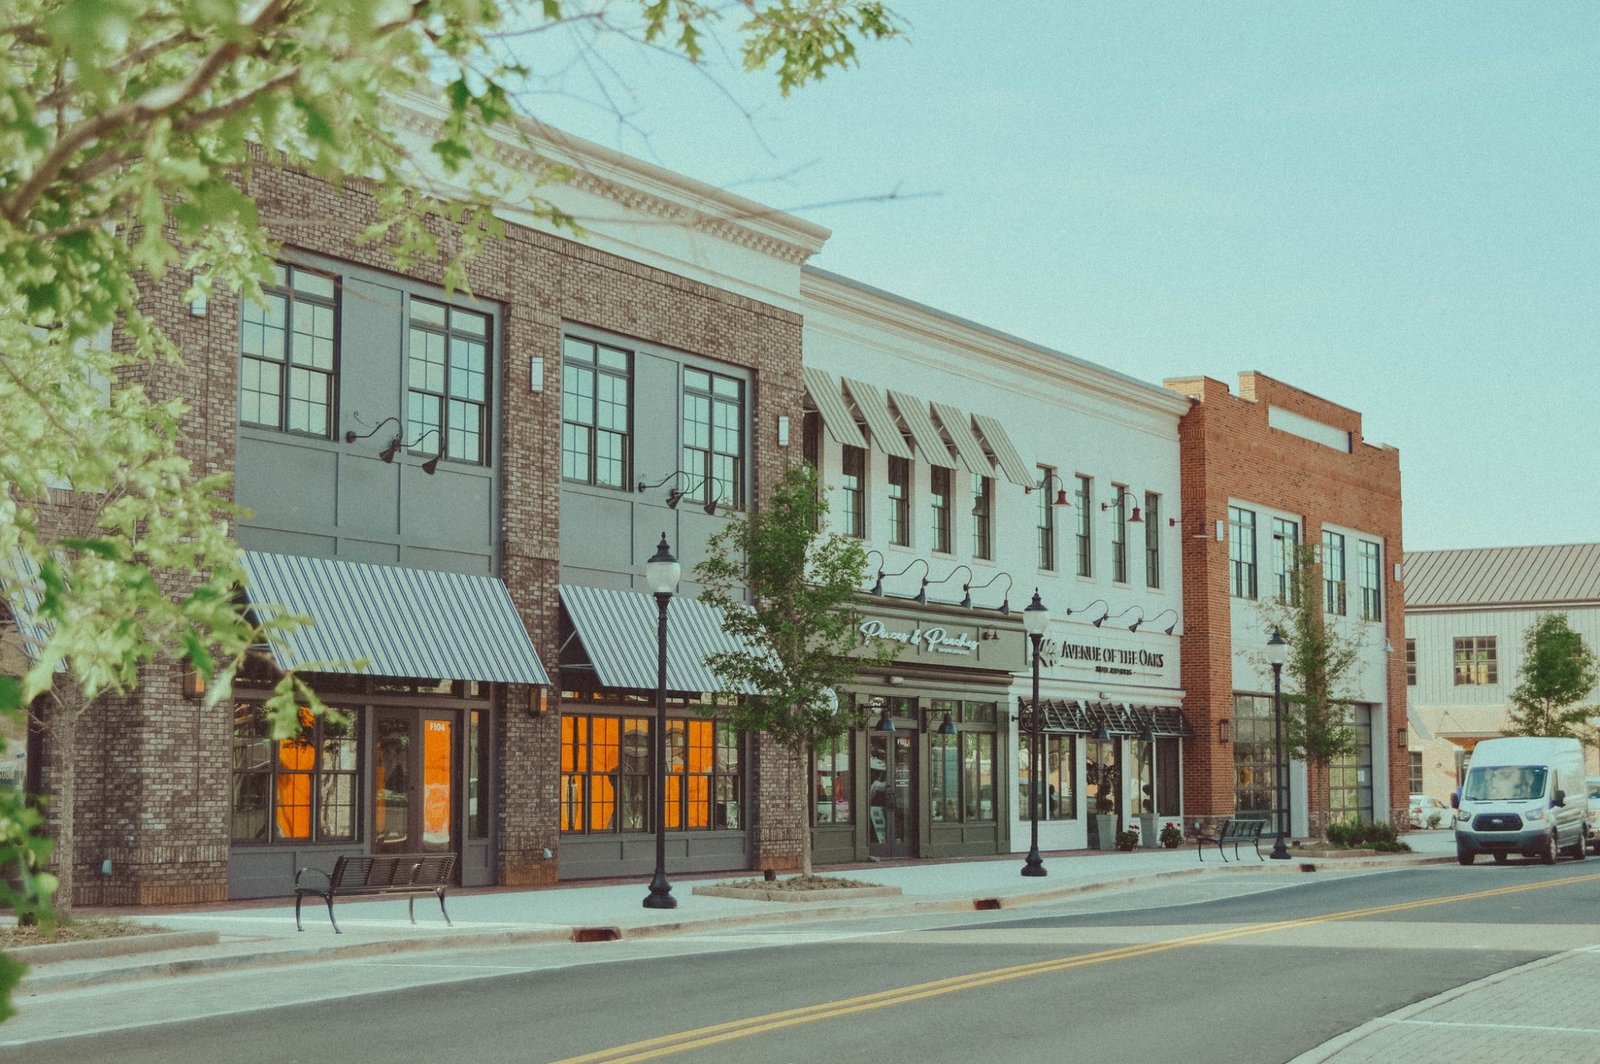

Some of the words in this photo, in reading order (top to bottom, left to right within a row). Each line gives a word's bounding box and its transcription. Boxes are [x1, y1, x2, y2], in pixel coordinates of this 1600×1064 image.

[910, 629, 922, 645] &
[1061, 640, 1101, 661] AVENUE
[1103, 647, 1117, 663] OF
[1118, 649, 1138, 665] THE
[1139, 649, 1164, 668] OAKS
[430, 722, 446, 732] F104
